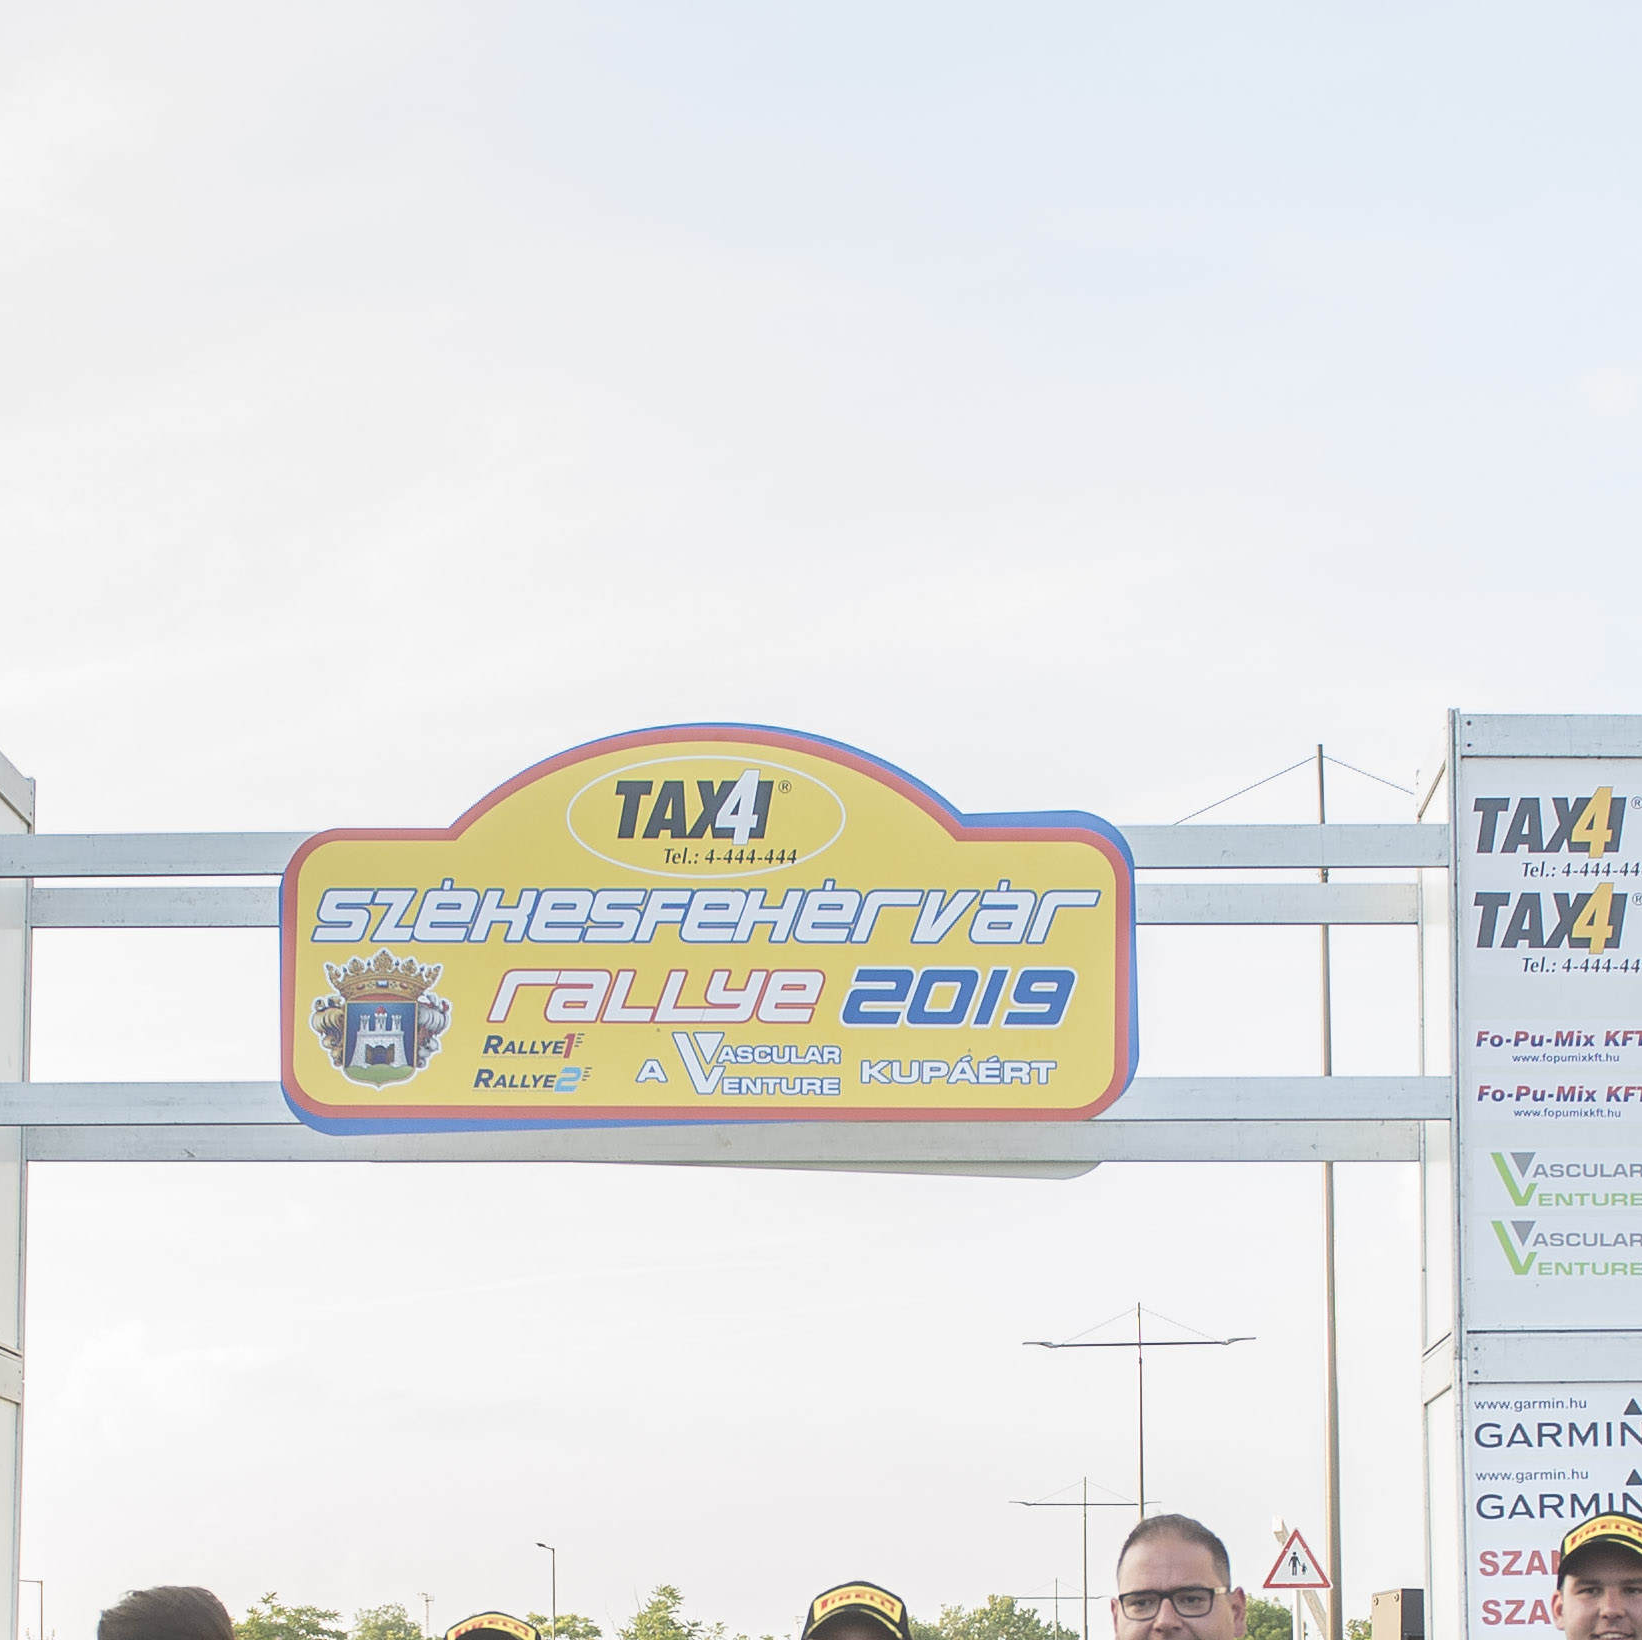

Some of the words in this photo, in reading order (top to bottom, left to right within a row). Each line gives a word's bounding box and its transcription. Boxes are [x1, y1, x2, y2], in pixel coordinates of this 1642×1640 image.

[663, 847, 699, 867] Tel.:
[704, 847, 799, 867] 4-444-444
[1521, 861, 1557, 878] Tel.:
[1521, 957, 1557, 973] Tel.:
[839, 966, 1077, 1028] 2019
[1475, 1030, 1596, 1049] Fo-Pu-Mix
[1511, 1052, 1621, 1064] www.fopumixkft.hu
[635, 1057, 668, 1085] A
[859, 1054, 1058, 1087] KUPÁÉRT
[1477, 1085, 1598, 1105] Fo-Pu-Mix
[1513, 1107, 1622, 1119] www.fopumixkft.hu
[1474, 1397, 1588, 1412] www.garmin.hu
[1475, 1468, 1589, 1483] www.garmin.hu
